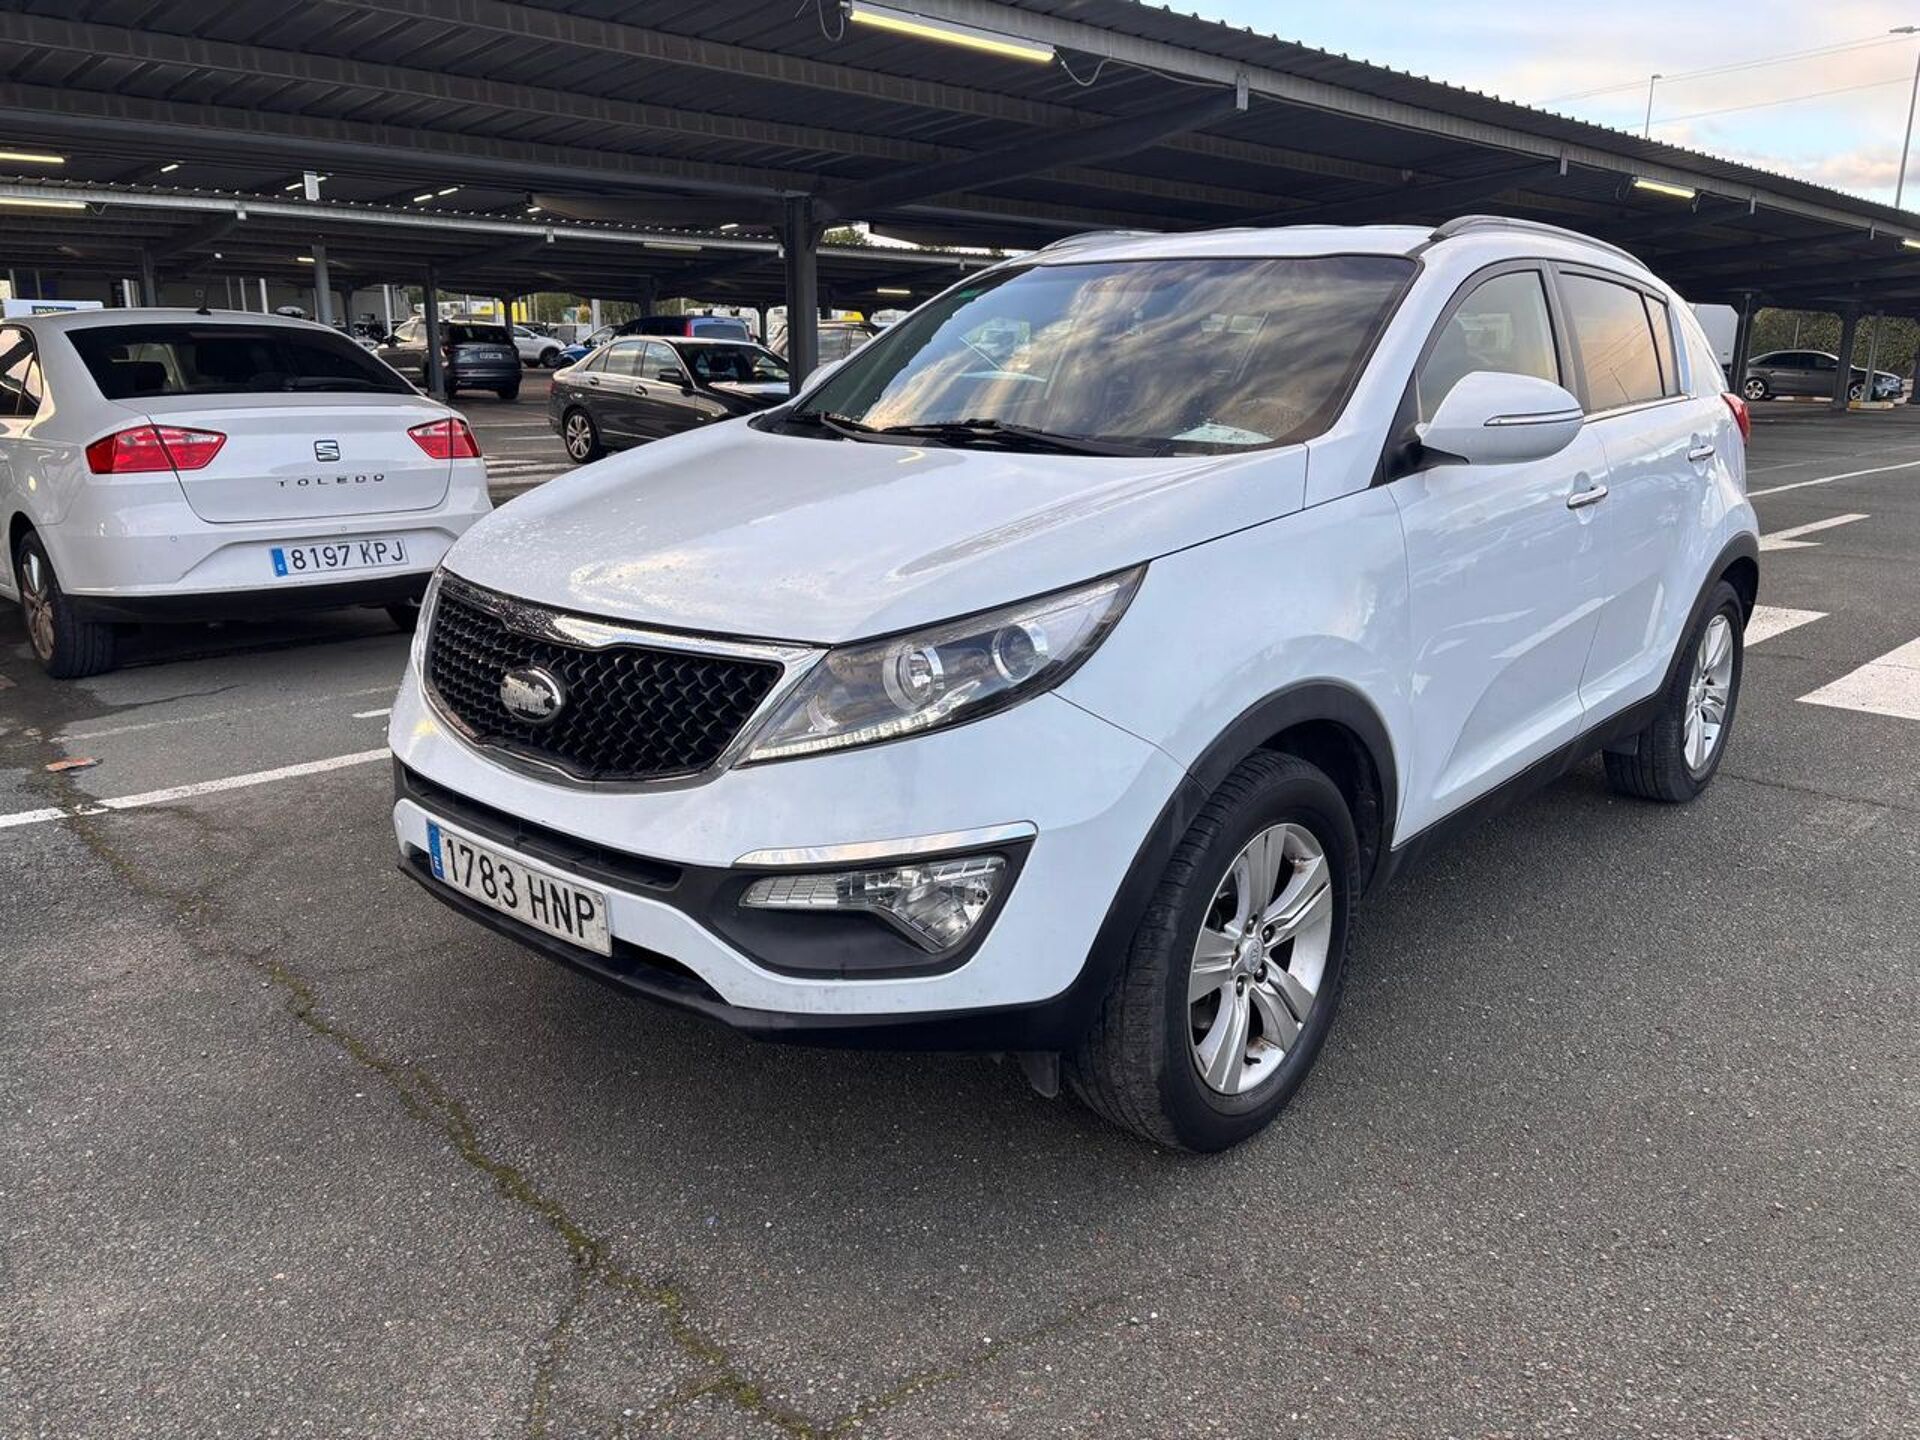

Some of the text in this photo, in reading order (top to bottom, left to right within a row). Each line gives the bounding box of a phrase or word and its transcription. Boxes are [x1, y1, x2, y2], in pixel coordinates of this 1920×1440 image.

[277, 473, 385, 487] TOLEDO
[291, 540, 403, 570] 8197 KPJ
[446, 838, 595, 938] 1783 HNP
